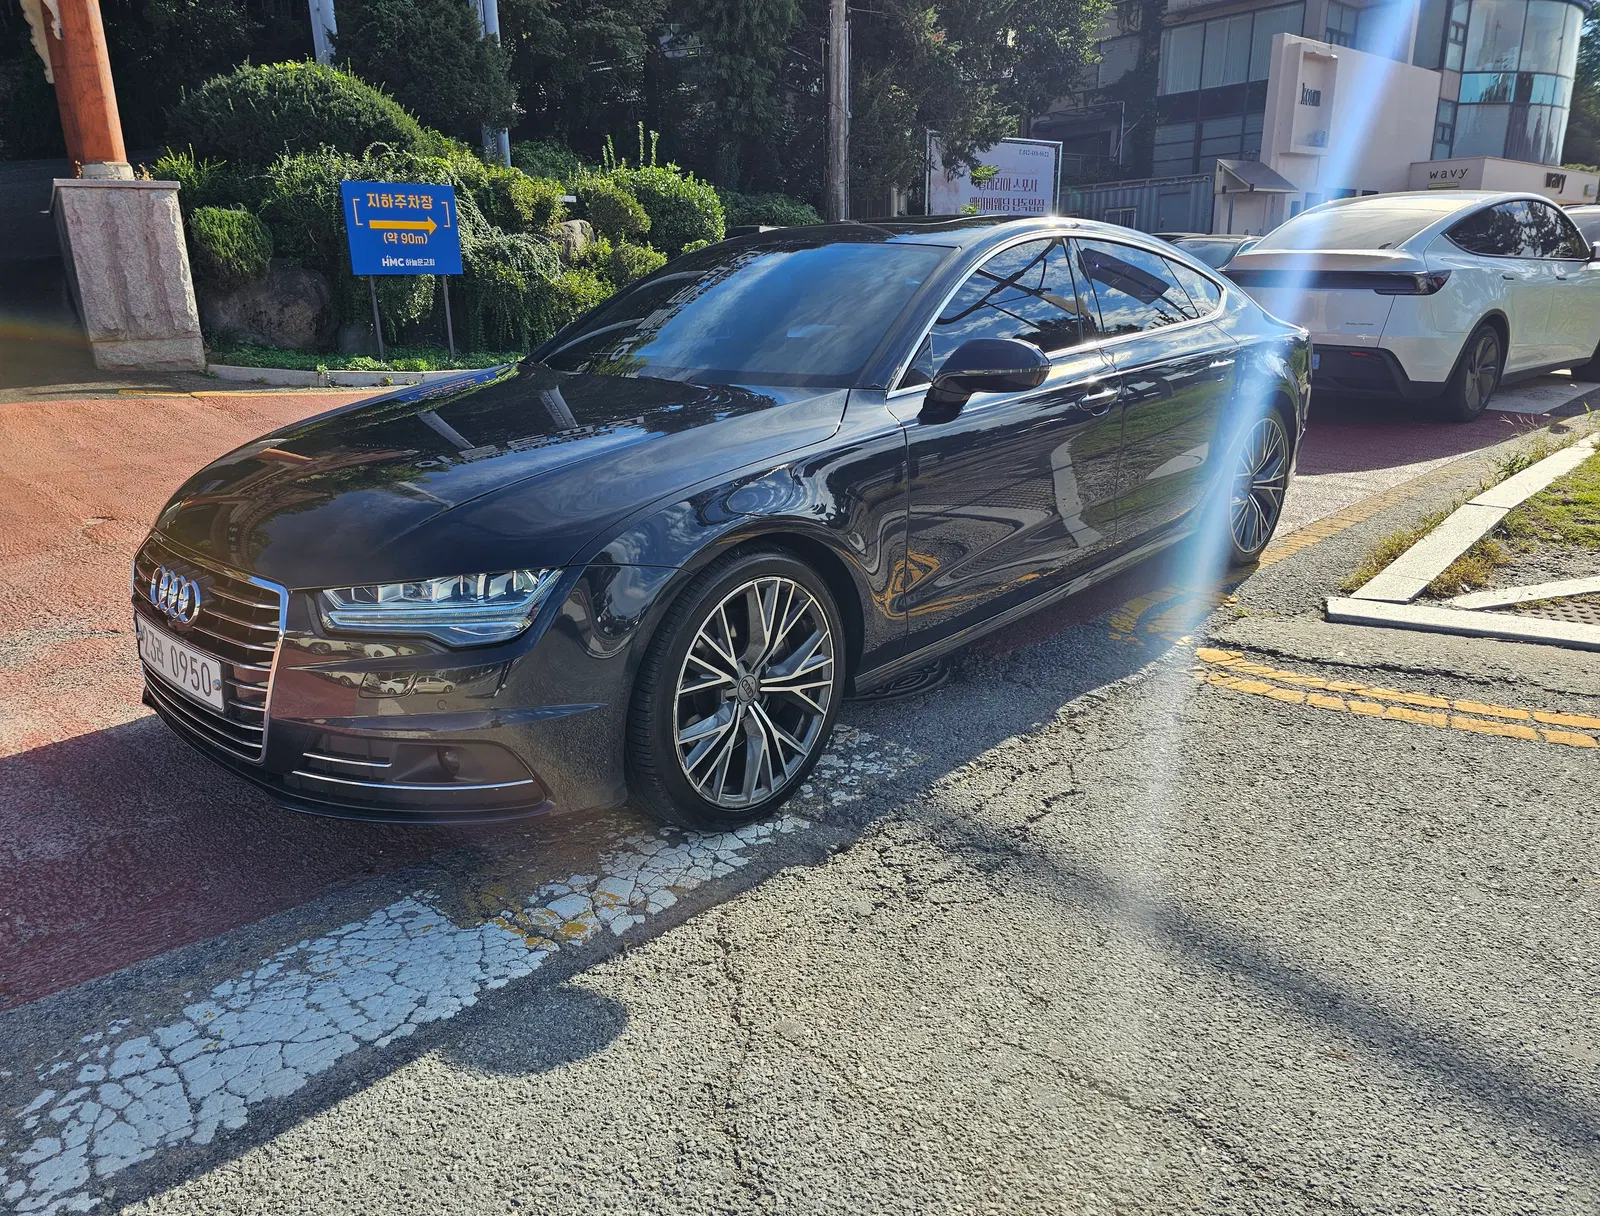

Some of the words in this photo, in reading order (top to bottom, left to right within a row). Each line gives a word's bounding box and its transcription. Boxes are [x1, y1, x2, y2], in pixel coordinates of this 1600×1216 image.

[1429, 167, 1469, 180] wavy
[1013, 178, 1038, 192] 스포사
[1545, 172, 1567, 194] wavy
[366, 193, 433, 210] 지하주차장
[1012, 198, 1045, 212] 단독입점
[383, 232, 398, 244] (약
[401, 232, 428, 244] 90m)
[381, 255, 405, 267] HMC
[170, 645, 212, 697] 0950
